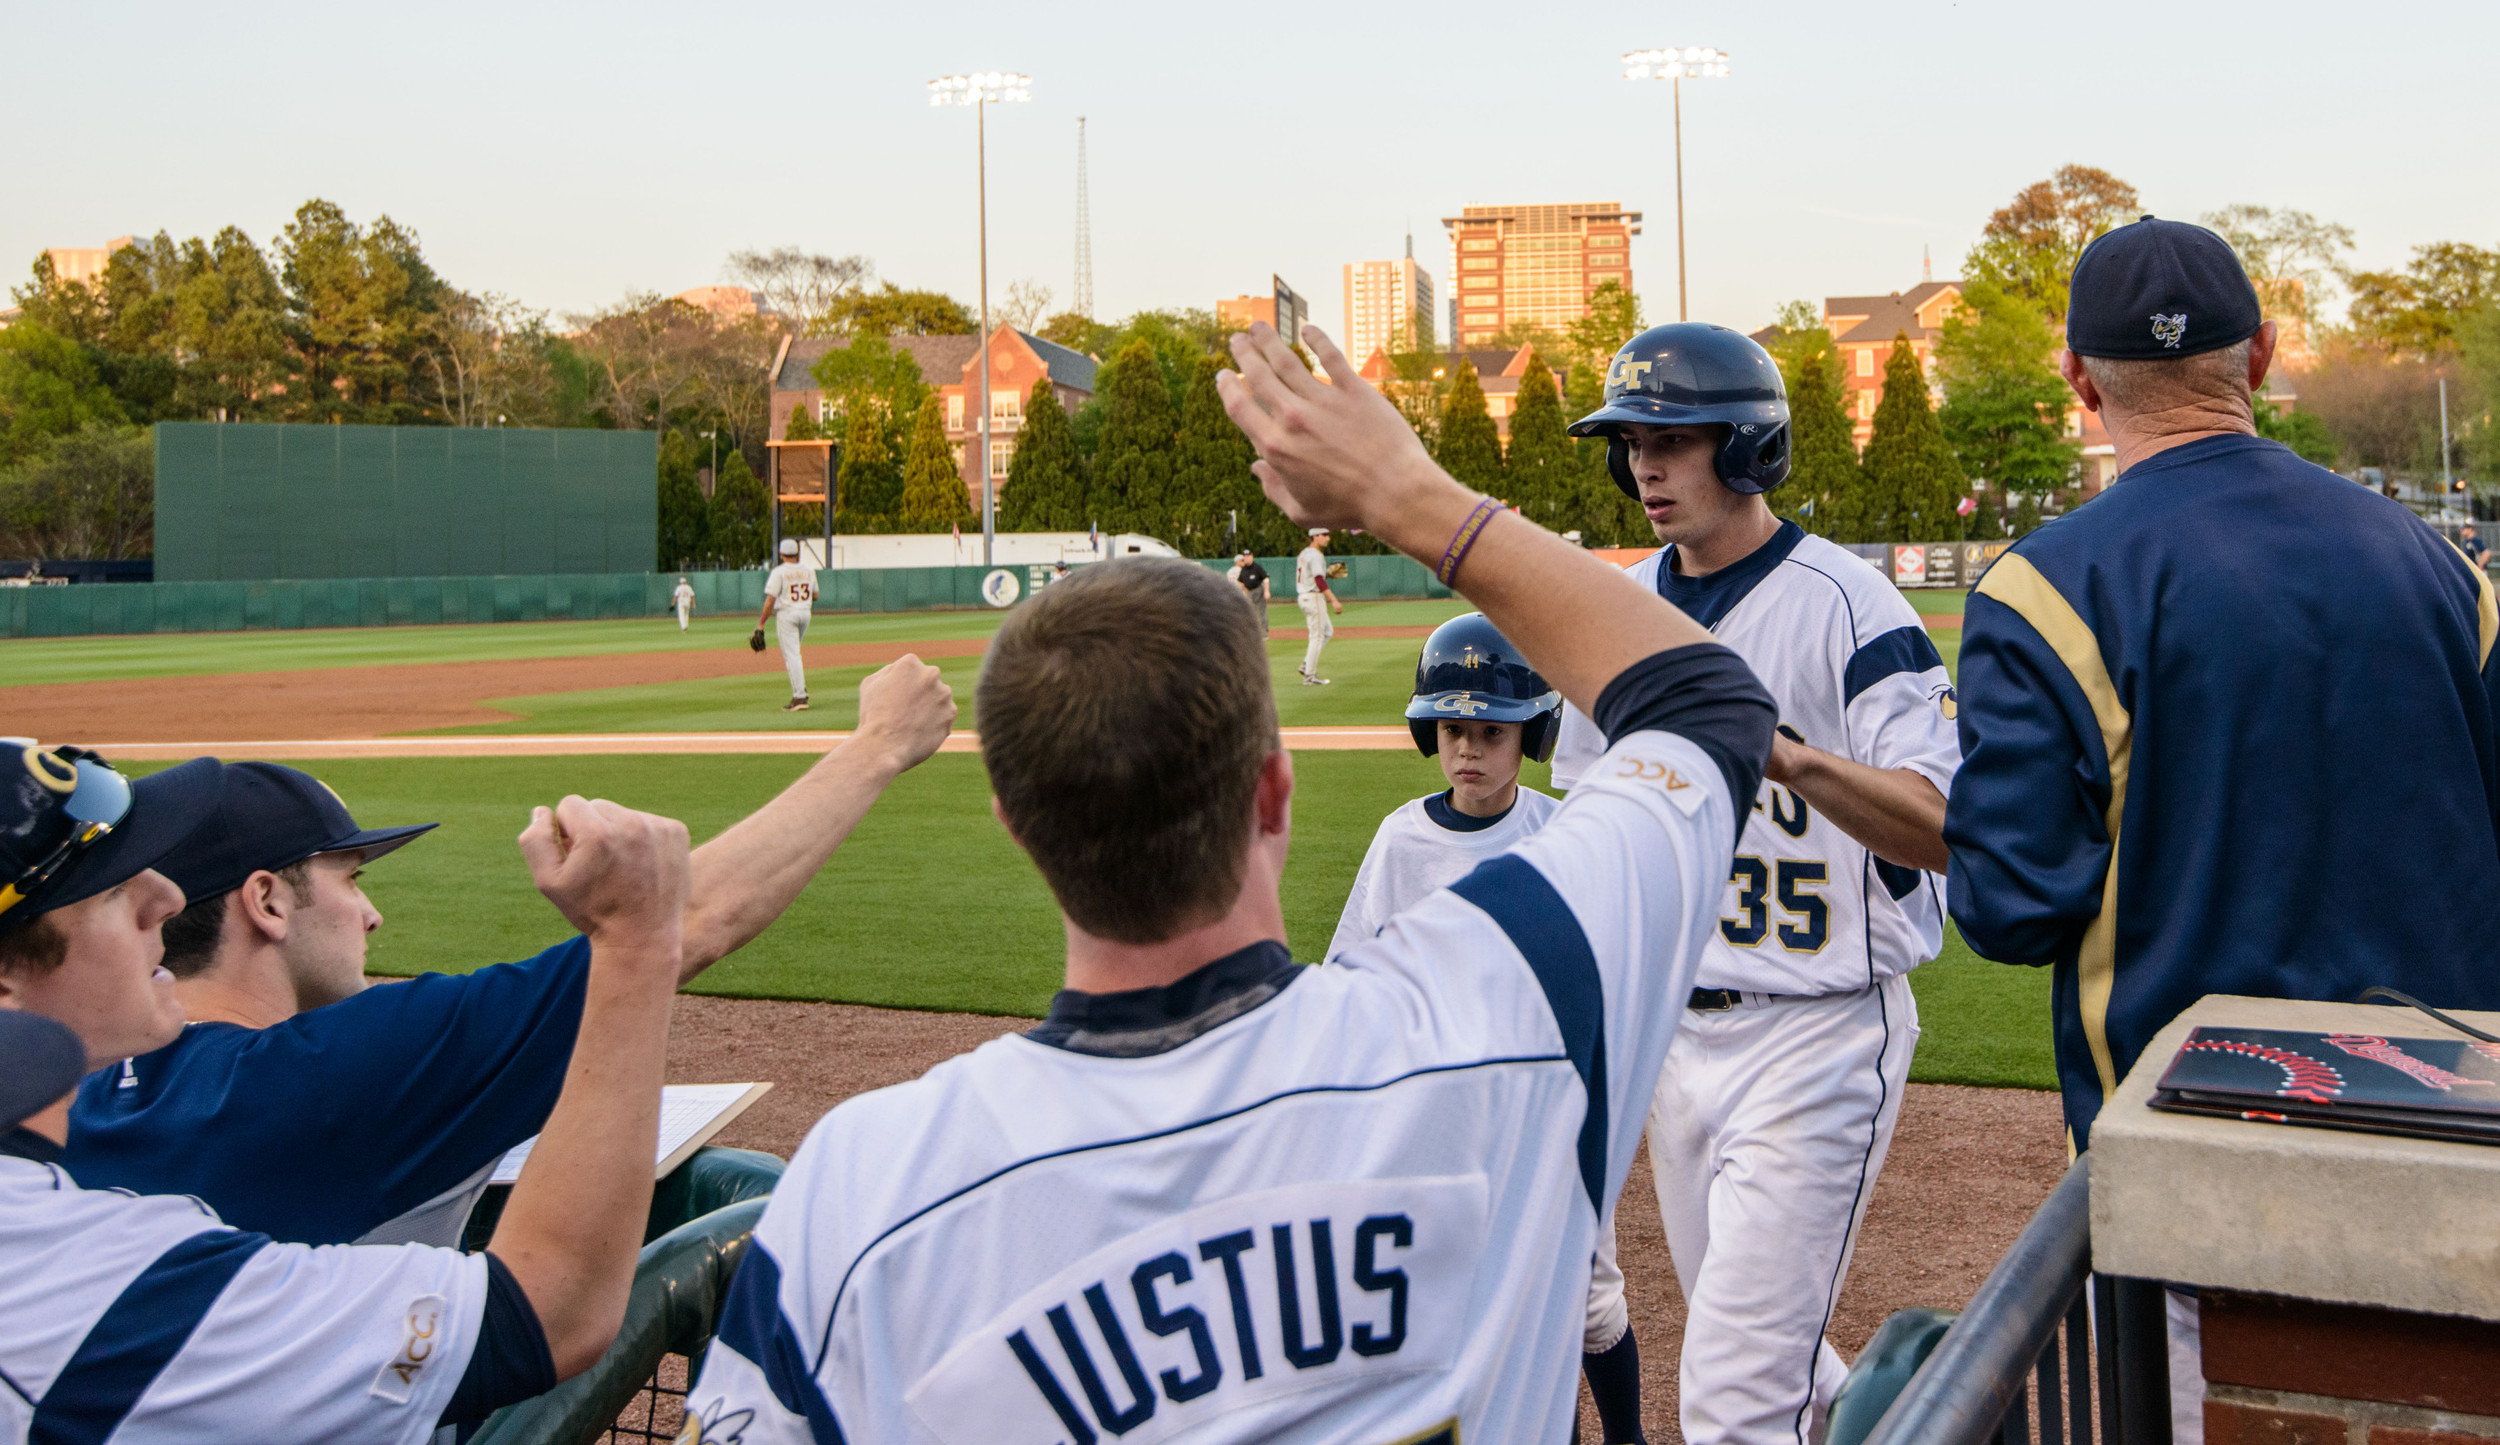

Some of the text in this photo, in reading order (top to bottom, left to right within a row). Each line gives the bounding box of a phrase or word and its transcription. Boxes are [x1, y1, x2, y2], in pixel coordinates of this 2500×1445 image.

[1607, 351, 1653, 390] GT
[790, 584, 810, 602] 53
[1465, 653, 1479, 669] 44
[1434, 694, 1488, 716] GT
[1617, 757, 1690, 790] ACC
[1719, 855, 1830, 954] 35
[1006, 1213, 1413, 1445] JUSTUS
[394, 1312, 438, 1384] ACC
